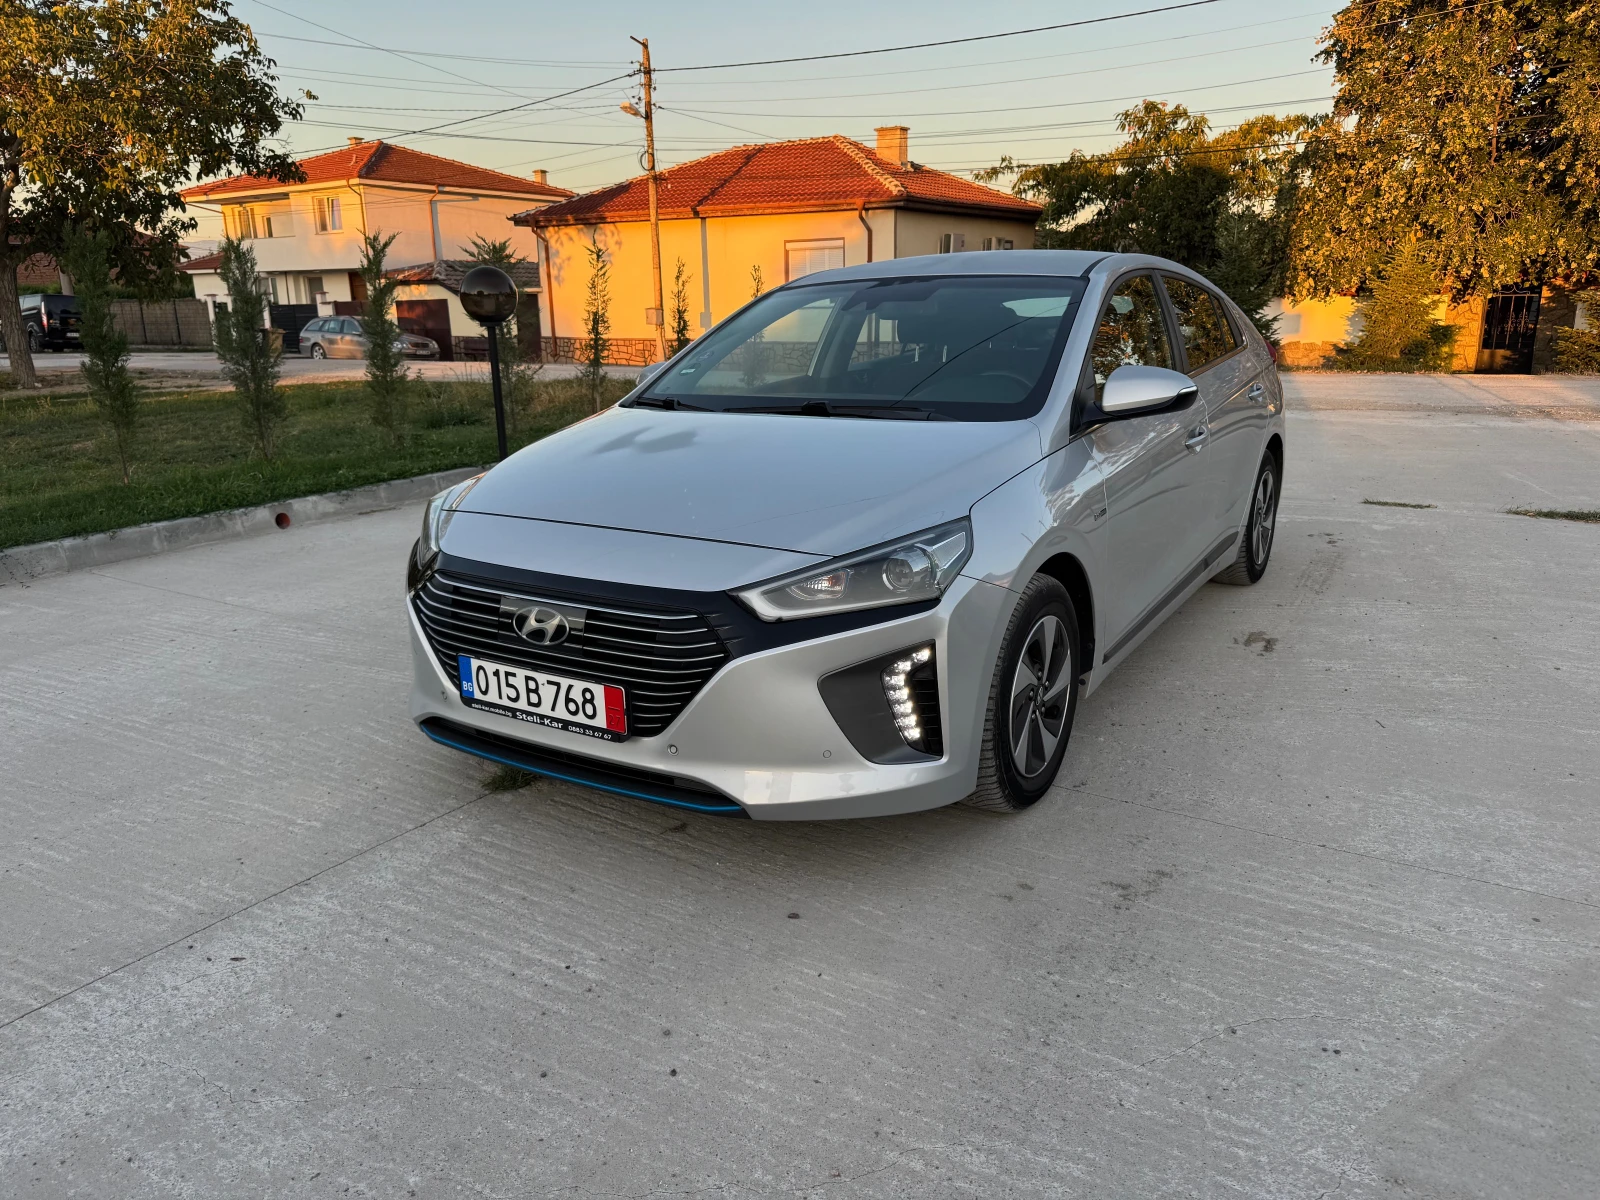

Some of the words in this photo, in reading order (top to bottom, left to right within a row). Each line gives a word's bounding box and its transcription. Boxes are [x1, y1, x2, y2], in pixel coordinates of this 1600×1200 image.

[462, 681, 474, 692] BG
[516, 711, 564, 729] Steli-Kar
[568, 725, 584, 734] 0883
